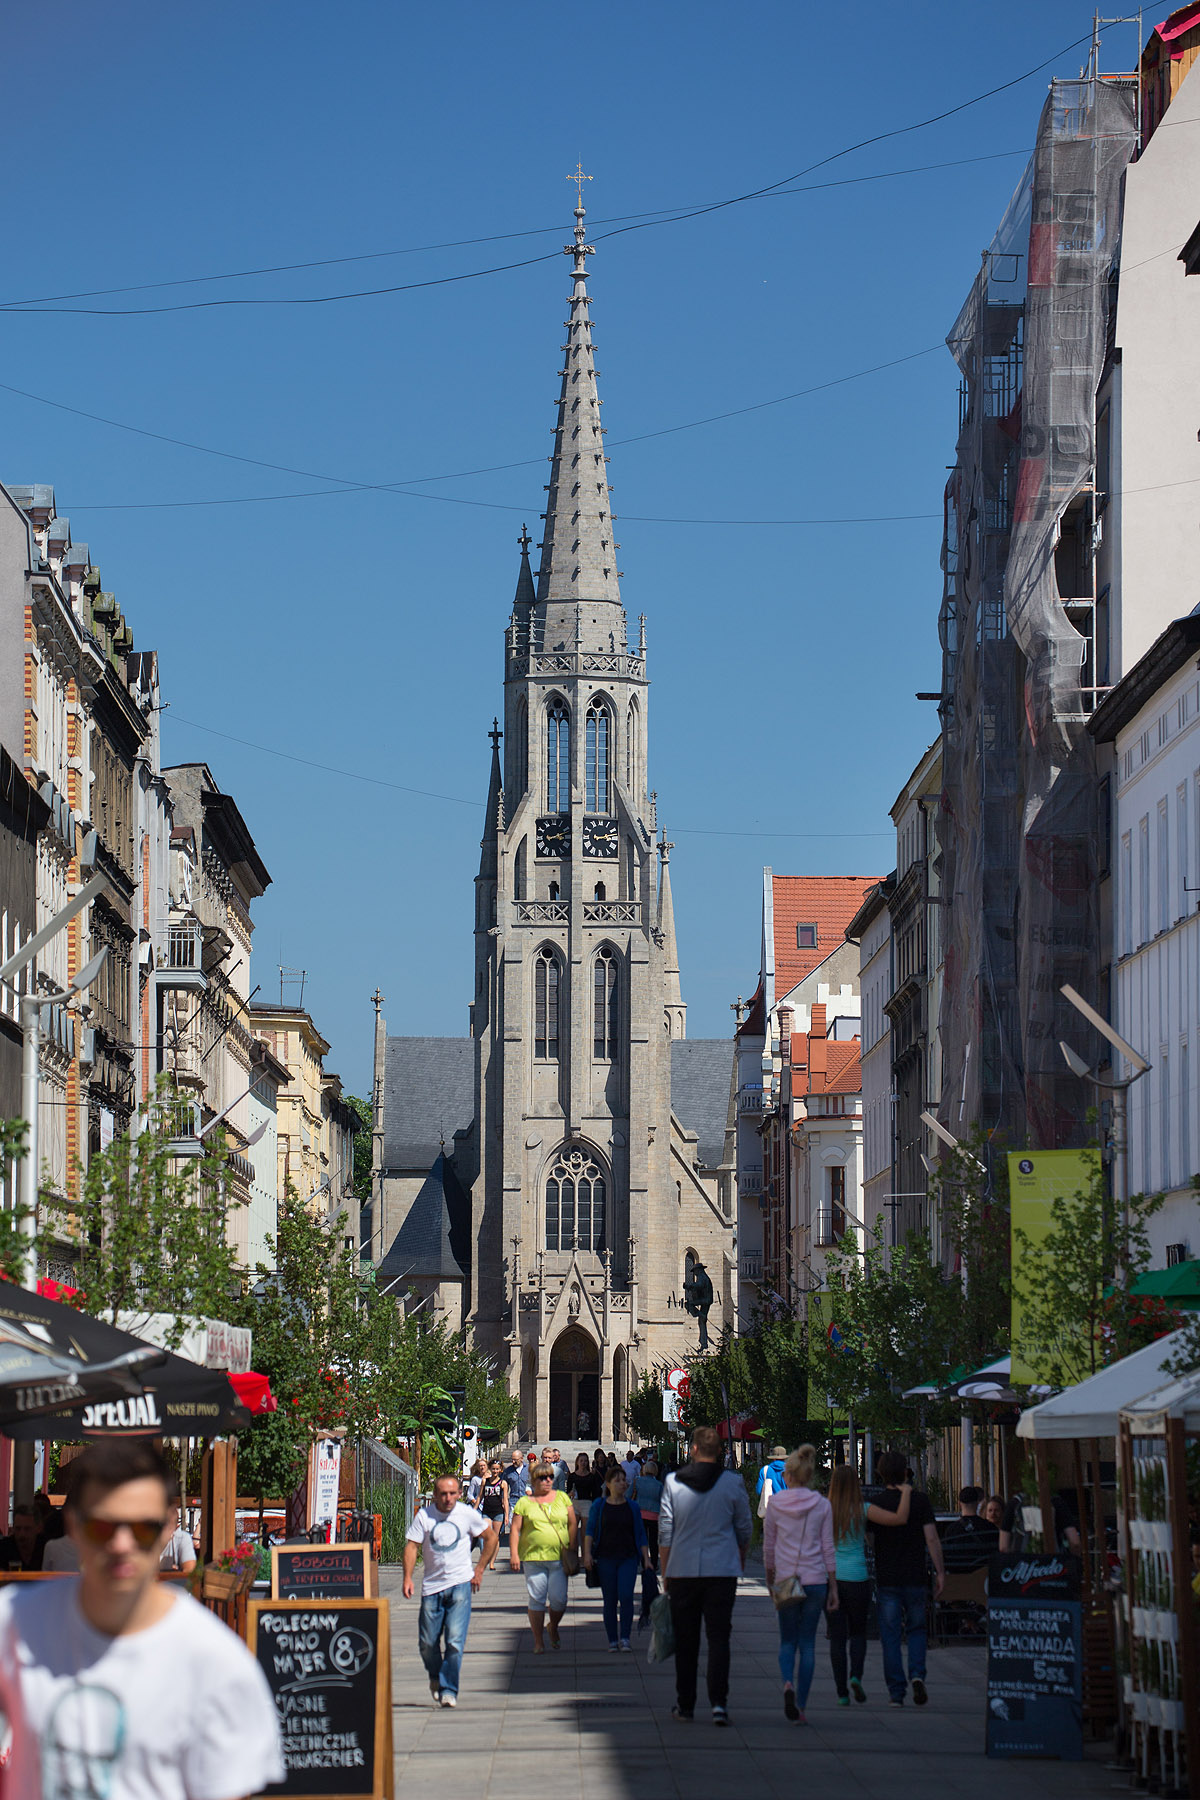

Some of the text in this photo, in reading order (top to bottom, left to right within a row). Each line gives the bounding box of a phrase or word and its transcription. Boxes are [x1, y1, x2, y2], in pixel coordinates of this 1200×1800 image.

[167, 1403, 219, 1416] NASZE PIWO
[291, 1555, 350, 1569] SOBOTA
[1001, 1557, 1064, 1584] Alfredo
[260, 1613, 339, 1633] POLECAMY
[990, 1609, 1020, 1620] KAWA
[276, 1632, 319, 1652] PIWO
[990, 1635, 1075, 1653] LEMONIADA
[273, 1651, 327, 1680] MAJER
